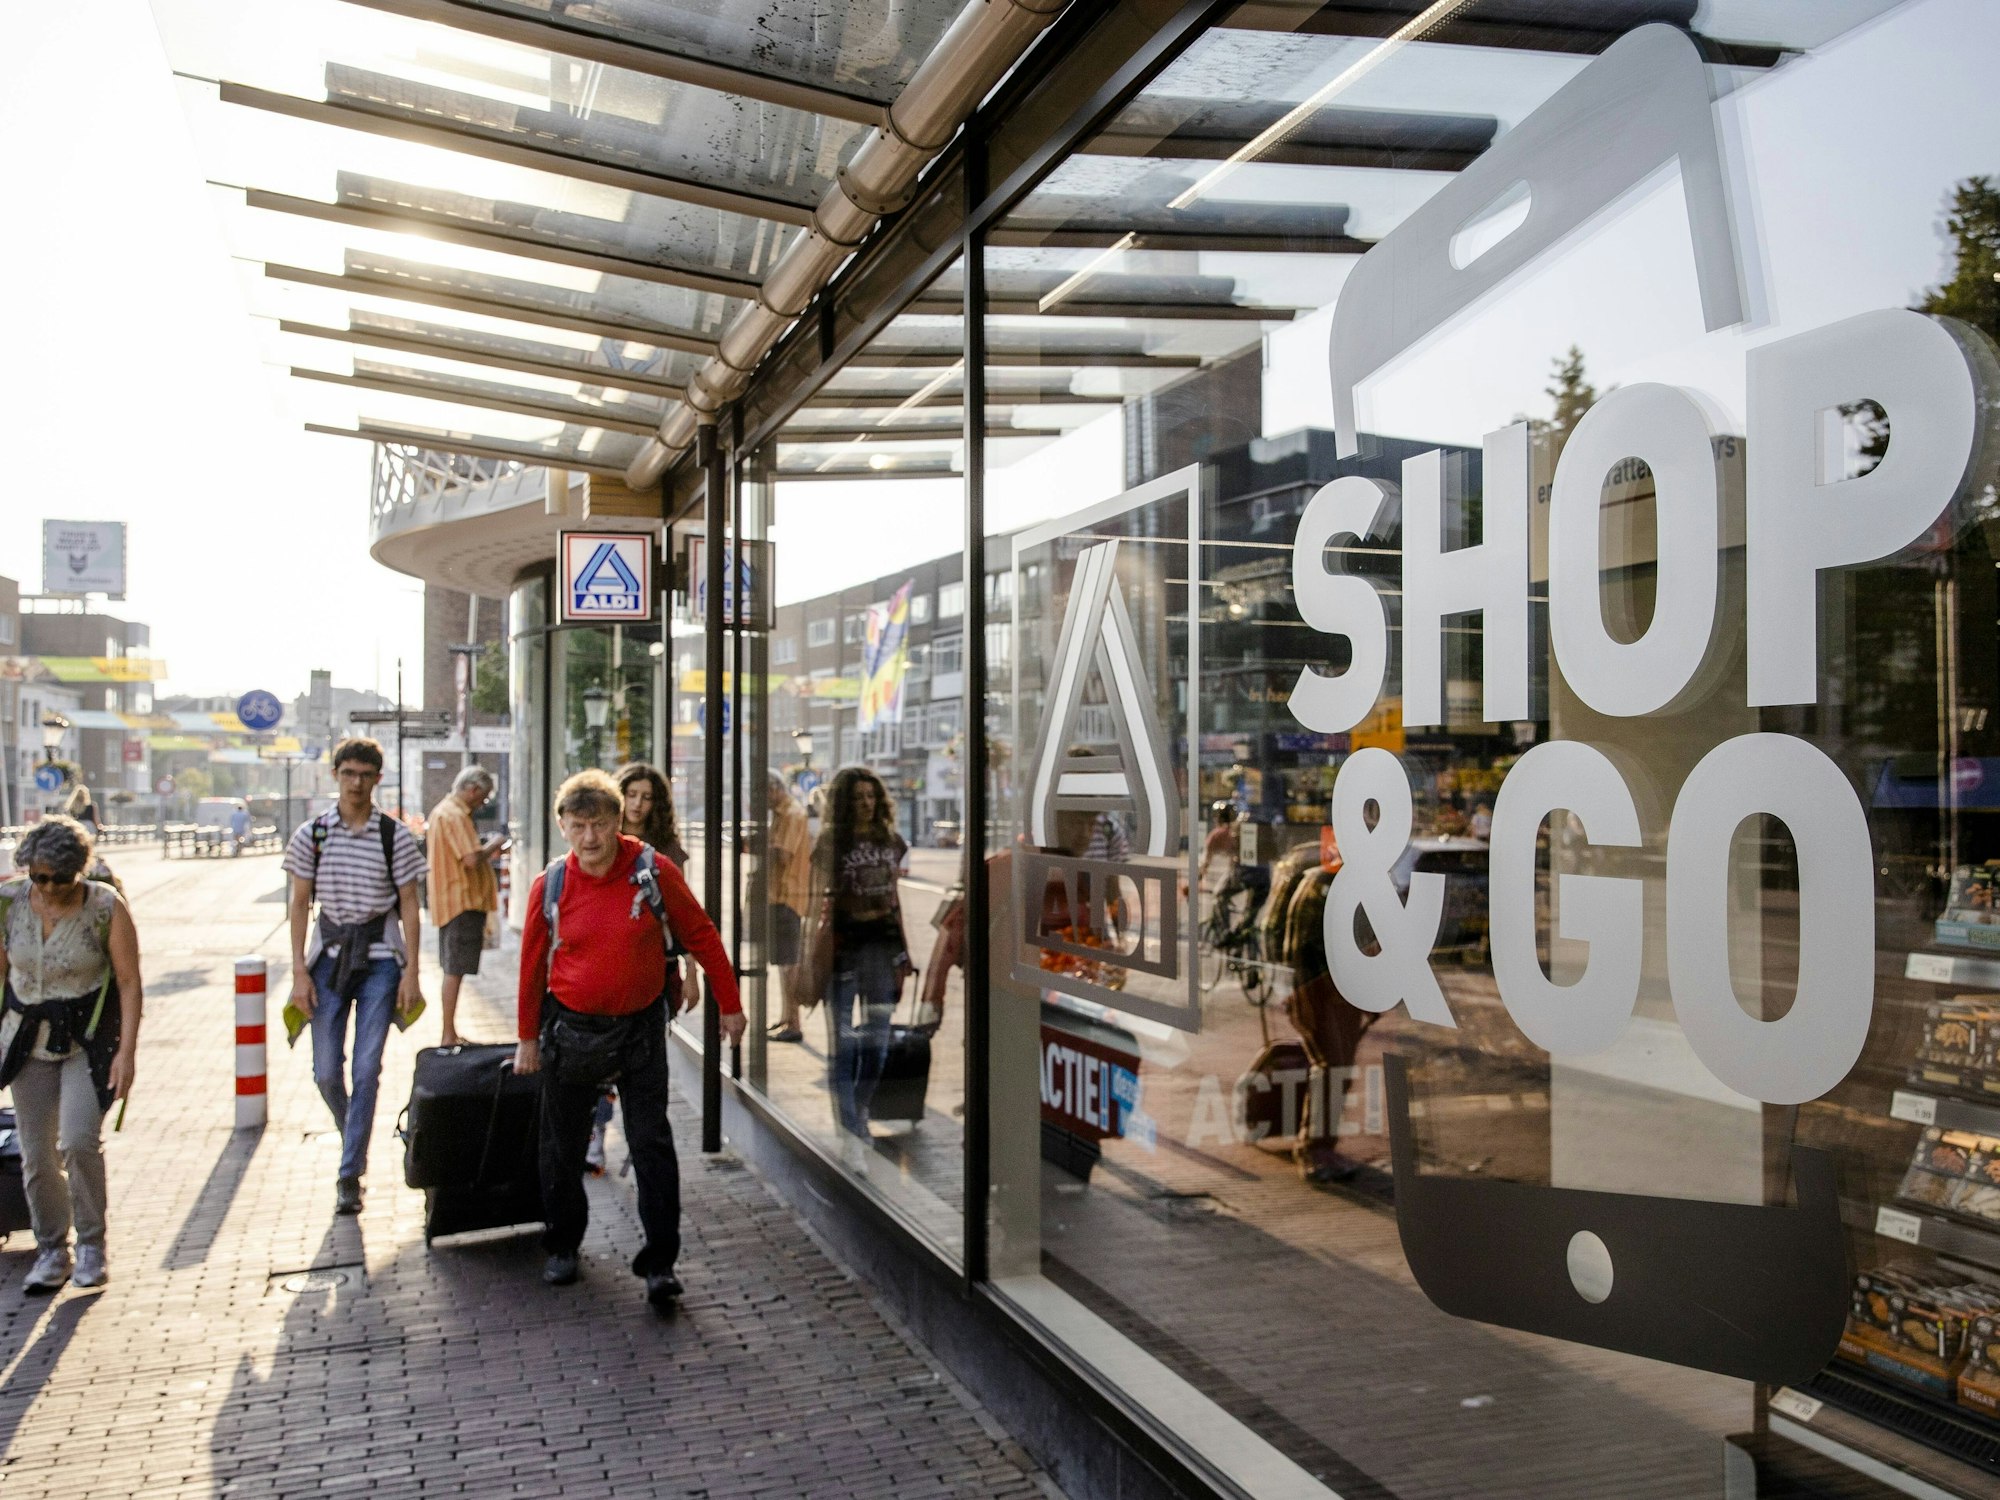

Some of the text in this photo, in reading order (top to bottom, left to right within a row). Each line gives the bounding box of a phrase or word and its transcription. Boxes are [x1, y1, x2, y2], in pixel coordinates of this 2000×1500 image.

[1287, 310, 1976, 732] SHOP
[582, 595, 635, 609] ALDI
[1036, 866, 1161, 964] ALDI
[1323, 732, 1876, 1105] & GO
[1186, 1065, 1383, 1148] ACTIE!
